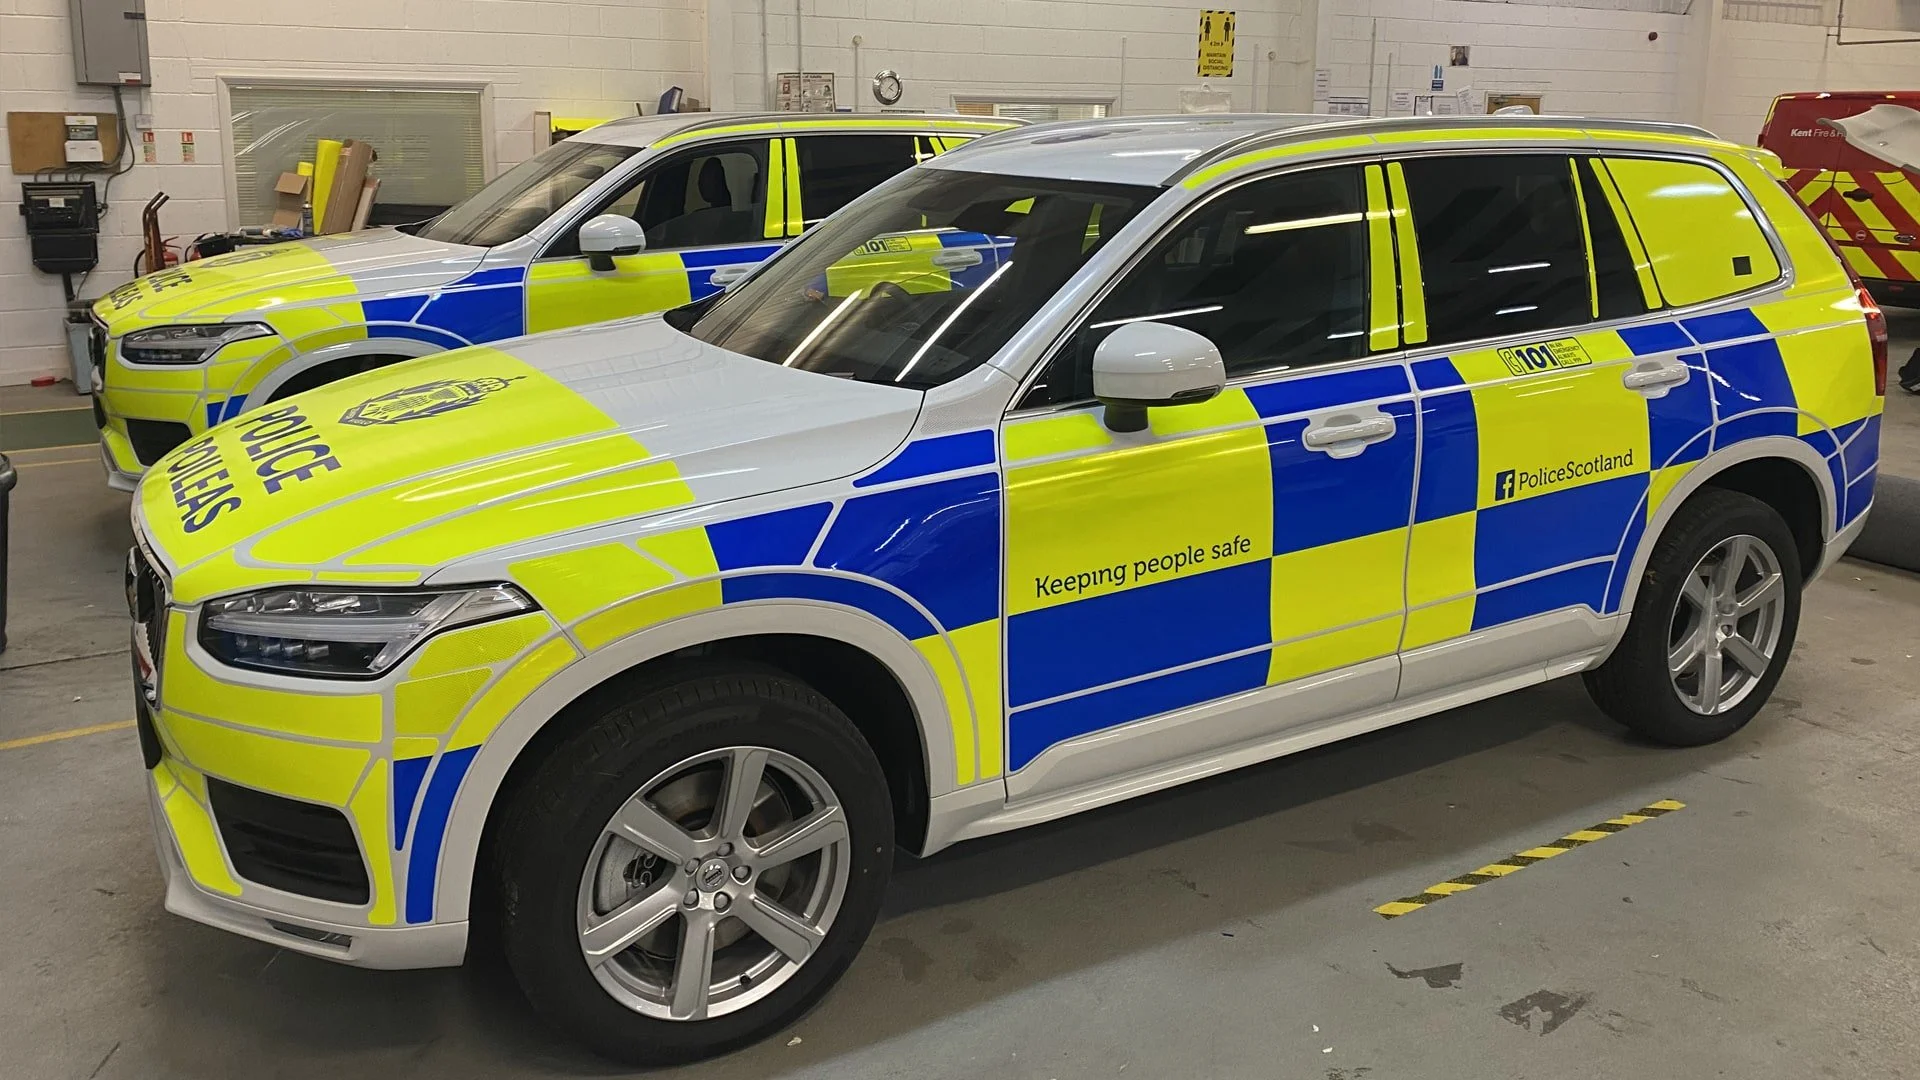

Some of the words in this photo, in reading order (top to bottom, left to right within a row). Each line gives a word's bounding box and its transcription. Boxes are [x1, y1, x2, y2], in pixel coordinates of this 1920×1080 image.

[1791, 128, 1812, 137] Kent
[1814, 128, 1829, 137] Fire
[1515, 345, 1558, 371] 101
[234, 405, 342, 495] POLICE
[1519, 448, 1634, 490] PoliceScotland
[165, 436, 242, 533] POILEAS
[1035, 564, 1127, 598] Keeping
[1133, 546, 1205, 581] people
[1211, 535, 1251, 560] safe
